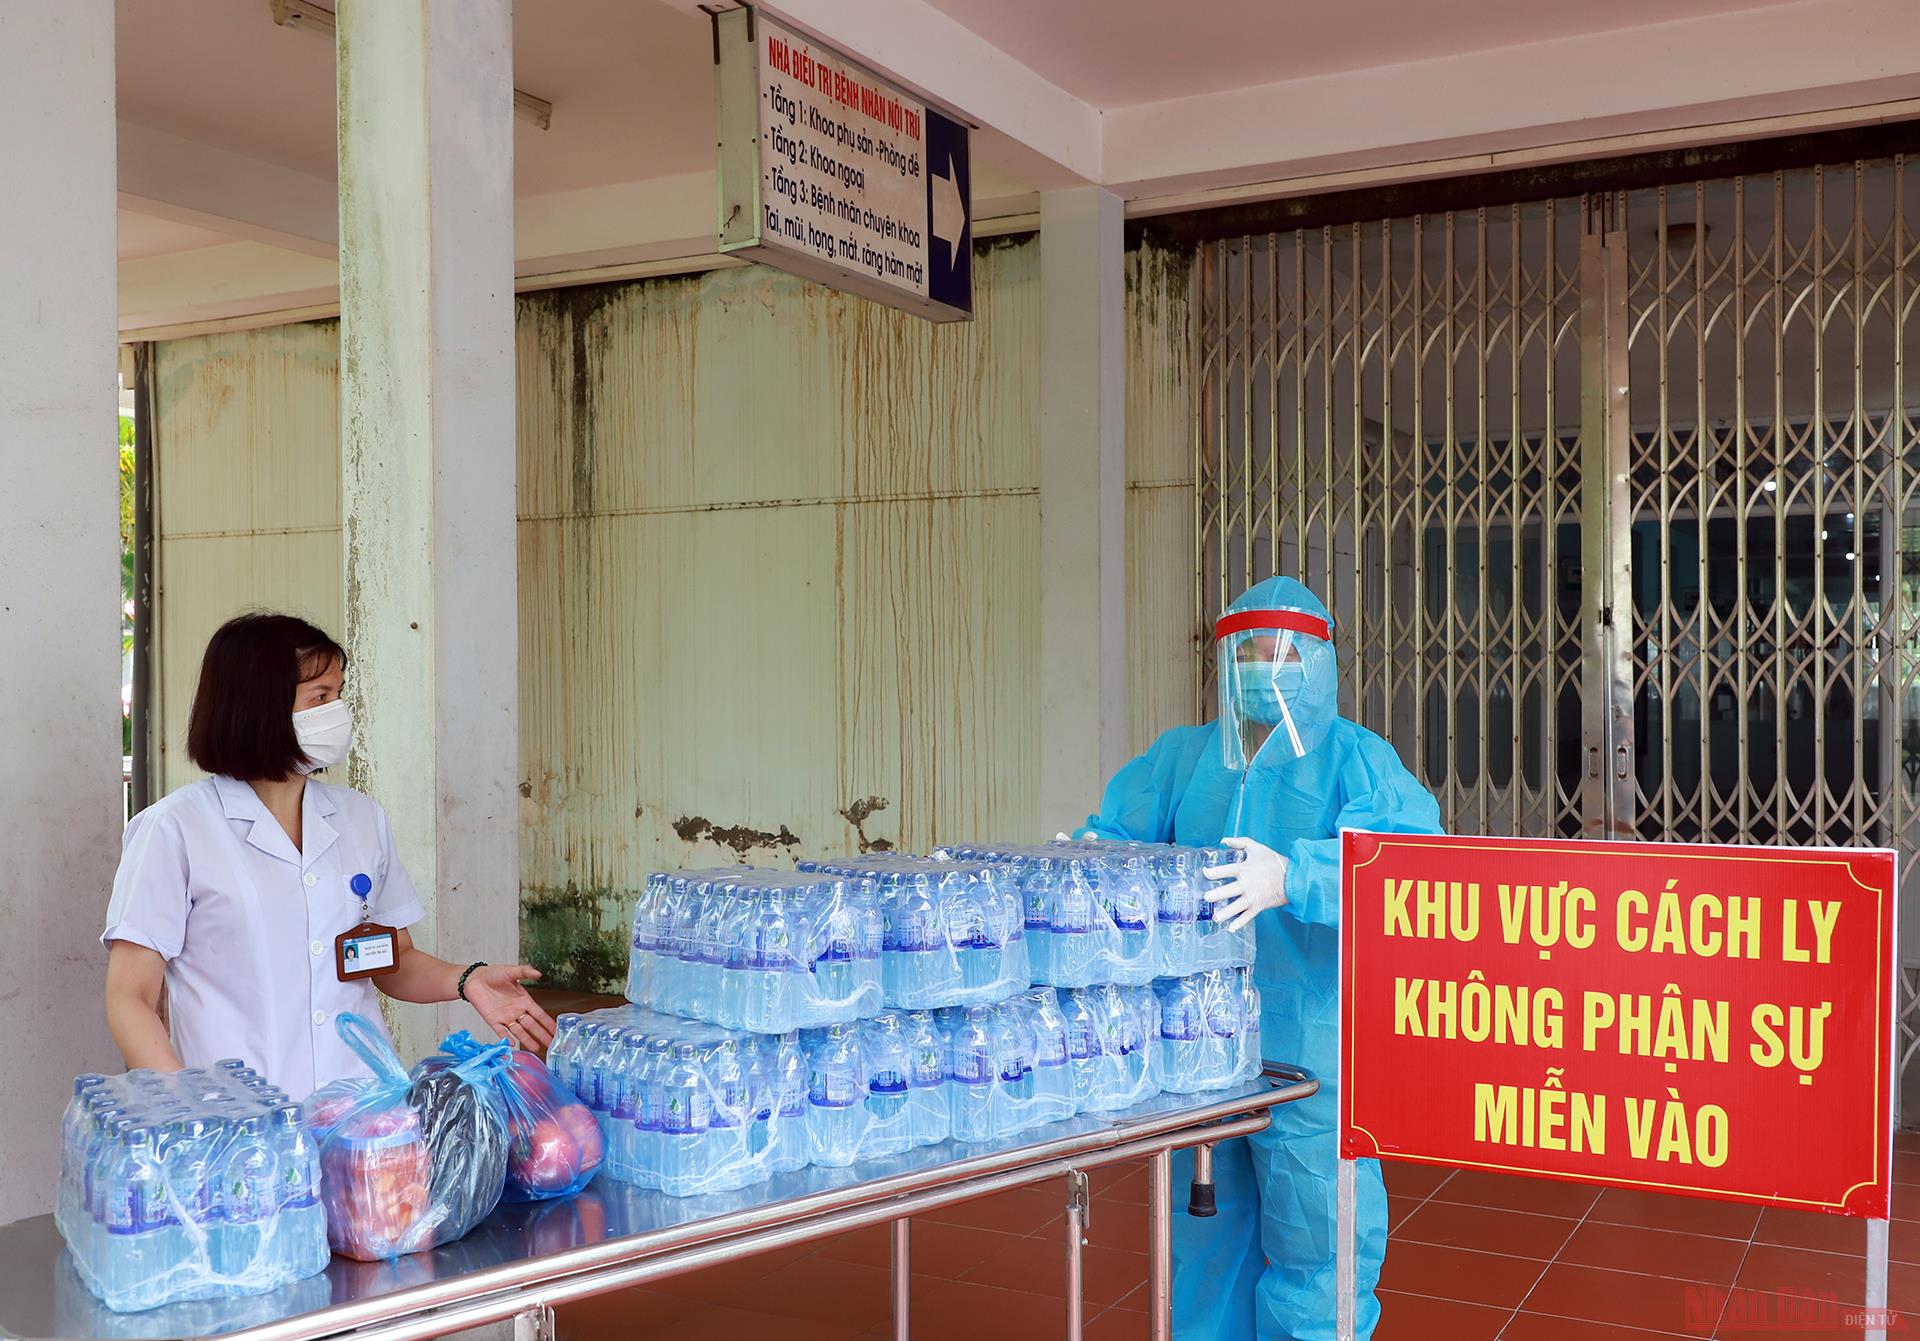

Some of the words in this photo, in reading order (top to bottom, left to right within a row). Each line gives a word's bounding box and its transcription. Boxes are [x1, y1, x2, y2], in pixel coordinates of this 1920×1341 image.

[769, 36, 790, 75] NHÀ
[792, 46, 815, 88] ĐIỀU
[817, 63, 832, 104] TRỊ
[834, 70, 859, 111] BỆNH
[861, 87, 886, 124] NHÂN
[888, 97, 902, 136] NỘI
[904, 109, 920, 141] TRÚ
[770, 83, 796, 126] Tầng
[799, 100, 807, 125] 1:
[810, 105, 835, 138] Khoa
[837, 122, 855, 153] phụ
[857, 127, 873, 156] sản
[908, 153, 920, 177] đẻ
[771, 124, 796, 165] Tầng
[799, 139, 808, 164] 2:
[810, 145, 835, 177] Khoa
[838, 162, 864, 193] ngoại
[765, 204, 781, 237] Tai,
[784, 216, 806, 246] mũi,
[809, 222, 836, 258] họng,
[862, 242, 882, 276] răng
[885, 251, 904, 278] hàm
[906, 261, 923, 289] mặt
[772, 165, 797, 205] Tầng
[800, 179, 808, 204] 3:
[811, 184, 835, 215] Bệnh
[838, 197, 861, 225] nhân
[863, 208, 896, 239] chuyên
[898, 220, 920, 248] khoa
[1383, 878, 1480, 942] KHU
[1497, 880, 1597, 961] VỰC
[1616, 878, 1762, 960] CÁCH
[1782, 899, 1843, 965] LY
[1393, 969, 1564, 1048] KHÔNG
[1582, 983, 1730, 1073] PHẬN
[1749, 1002, 1833, 1086] SỰ
[1473, 1067, 1606, 1156] MIỄN
[1624, 1086, 1729, 1168] VÀO
